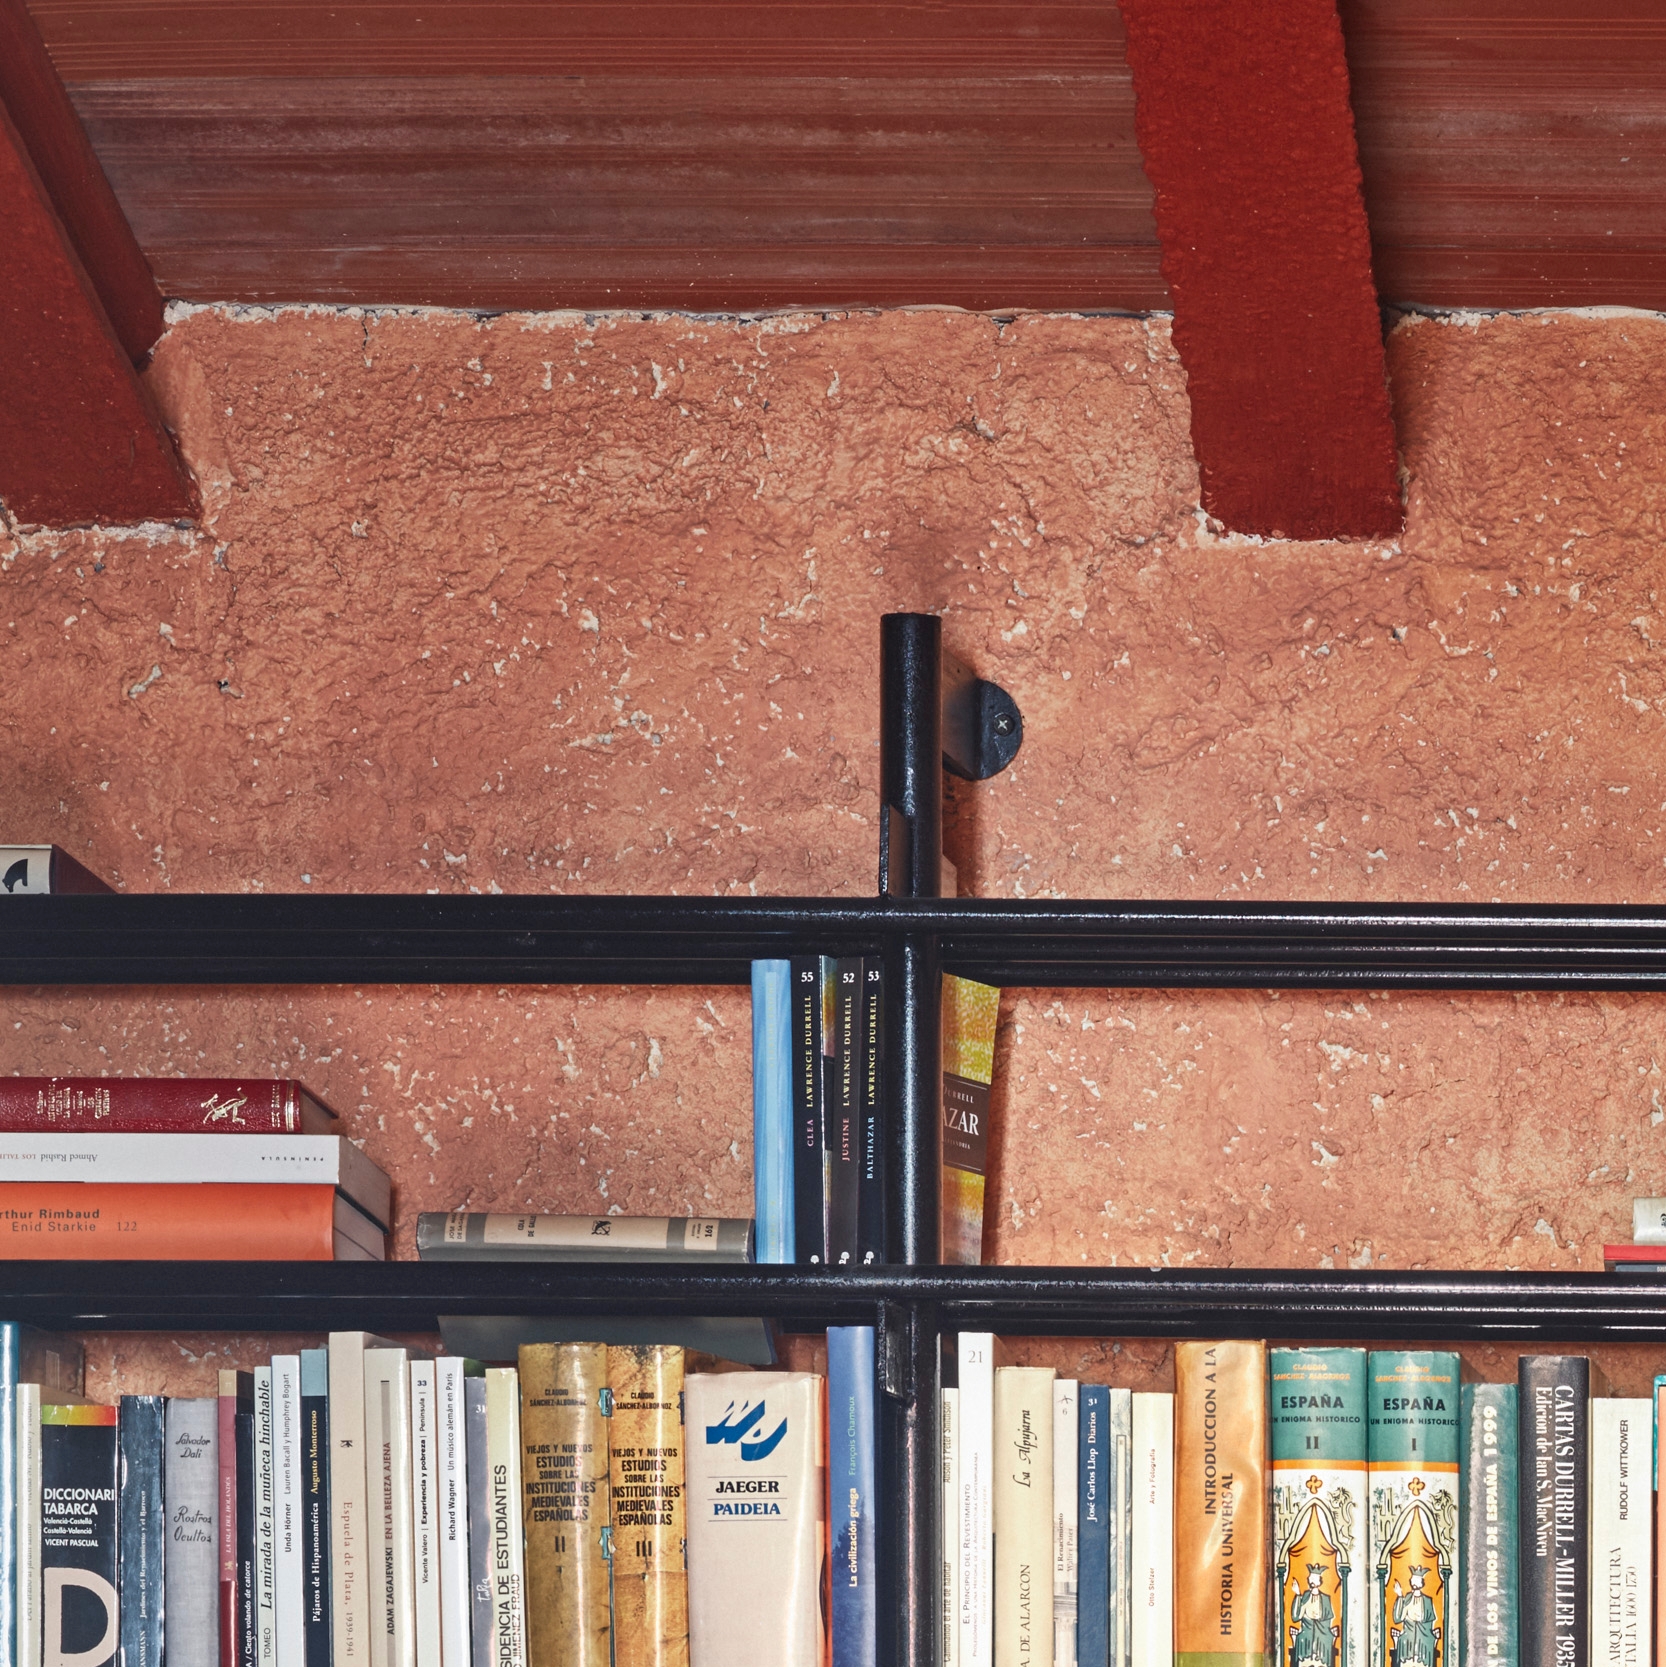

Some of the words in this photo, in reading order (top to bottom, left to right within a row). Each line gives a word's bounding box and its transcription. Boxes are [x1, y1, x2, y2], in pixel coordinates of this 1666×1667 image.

[801, 972, 814, 982] 55
[804, 995, 812, 1045] DURRELL
[805, 1050, 813, 1107] LAWRENCE
[0, 1209, 33, 1219] rthur
[39, 1209, 100, 1219] Rimbaud
[12, 1221, 42, 1232] Enid
[48, 1221, 96, 1232] Starkie
[117, 1221, 137, 1232] 122
[1279, 1392, 1344, 1412] ESPAÑA
[258, 1380, 271, 1446] hinchable
[259, 1449, 271, 1502] muñeca
[43, 1488, 115, 1501] DICCIONARI
[716, 1481, 779, 1493] JAEGER
[43, 1502, 98, 1515] TABARCA
[260, 1505, 271, 1518] la
[714, 1503, 780, 1515] PAIDEIA
[260, 1522, 272, 1540] de
[260, 1541, 272, 1591] mirada
[261, 1593, 272, 1610] La
[263, 1627, 271, 1658] TOMEO
